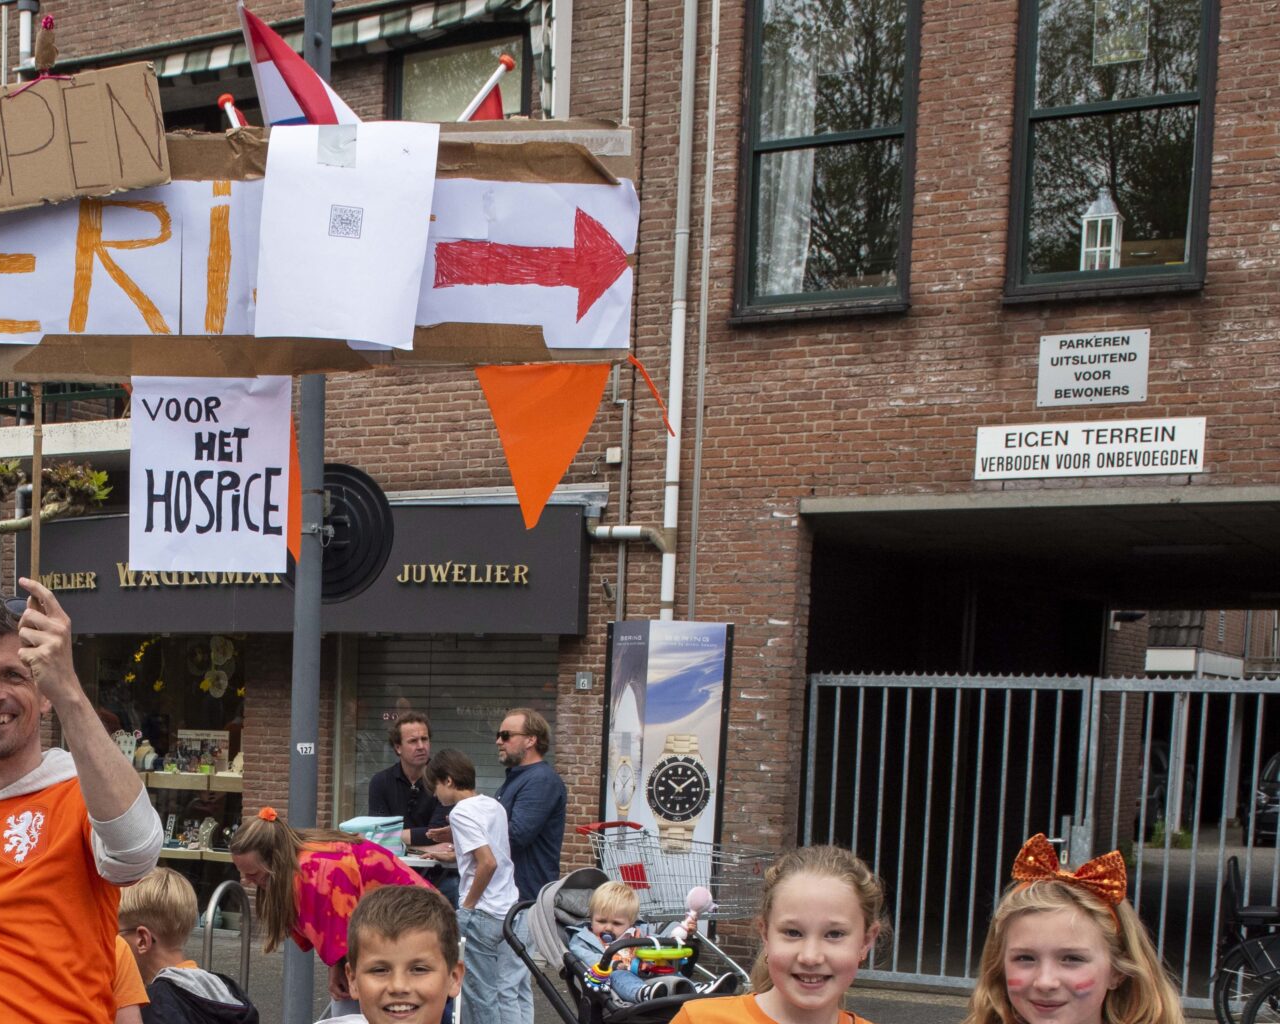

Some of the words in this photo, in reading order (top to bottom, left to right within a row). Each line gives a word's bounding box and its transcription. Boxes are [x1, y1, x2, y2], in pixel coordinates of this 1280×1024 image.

[1058, 336, 1131, 349] PARKEREN
[1050, 352, 1138, 367] UITSLUITEND
[1074, 370, 1111, 382] VOOR
[1054, 385, 1130, 399] BEWONERS
[142, 396, 222, 424] VOOR
[194, 427, 251, 463] HET
[1004, 430, 1069, 448] EIGEN
[1081, 426, 1176, 446] TERREIN
[981, 455, 1050, 473] VERBODEN
[1055, 453, 1091, 470] VOOR
[1096, 449, 1199, 469] ONBEVOEGDEN
[39, 571, 97, 591] WELIER
[396, 560, 529, 585] JUWELIER
[300, 746, 313, 754] 127
